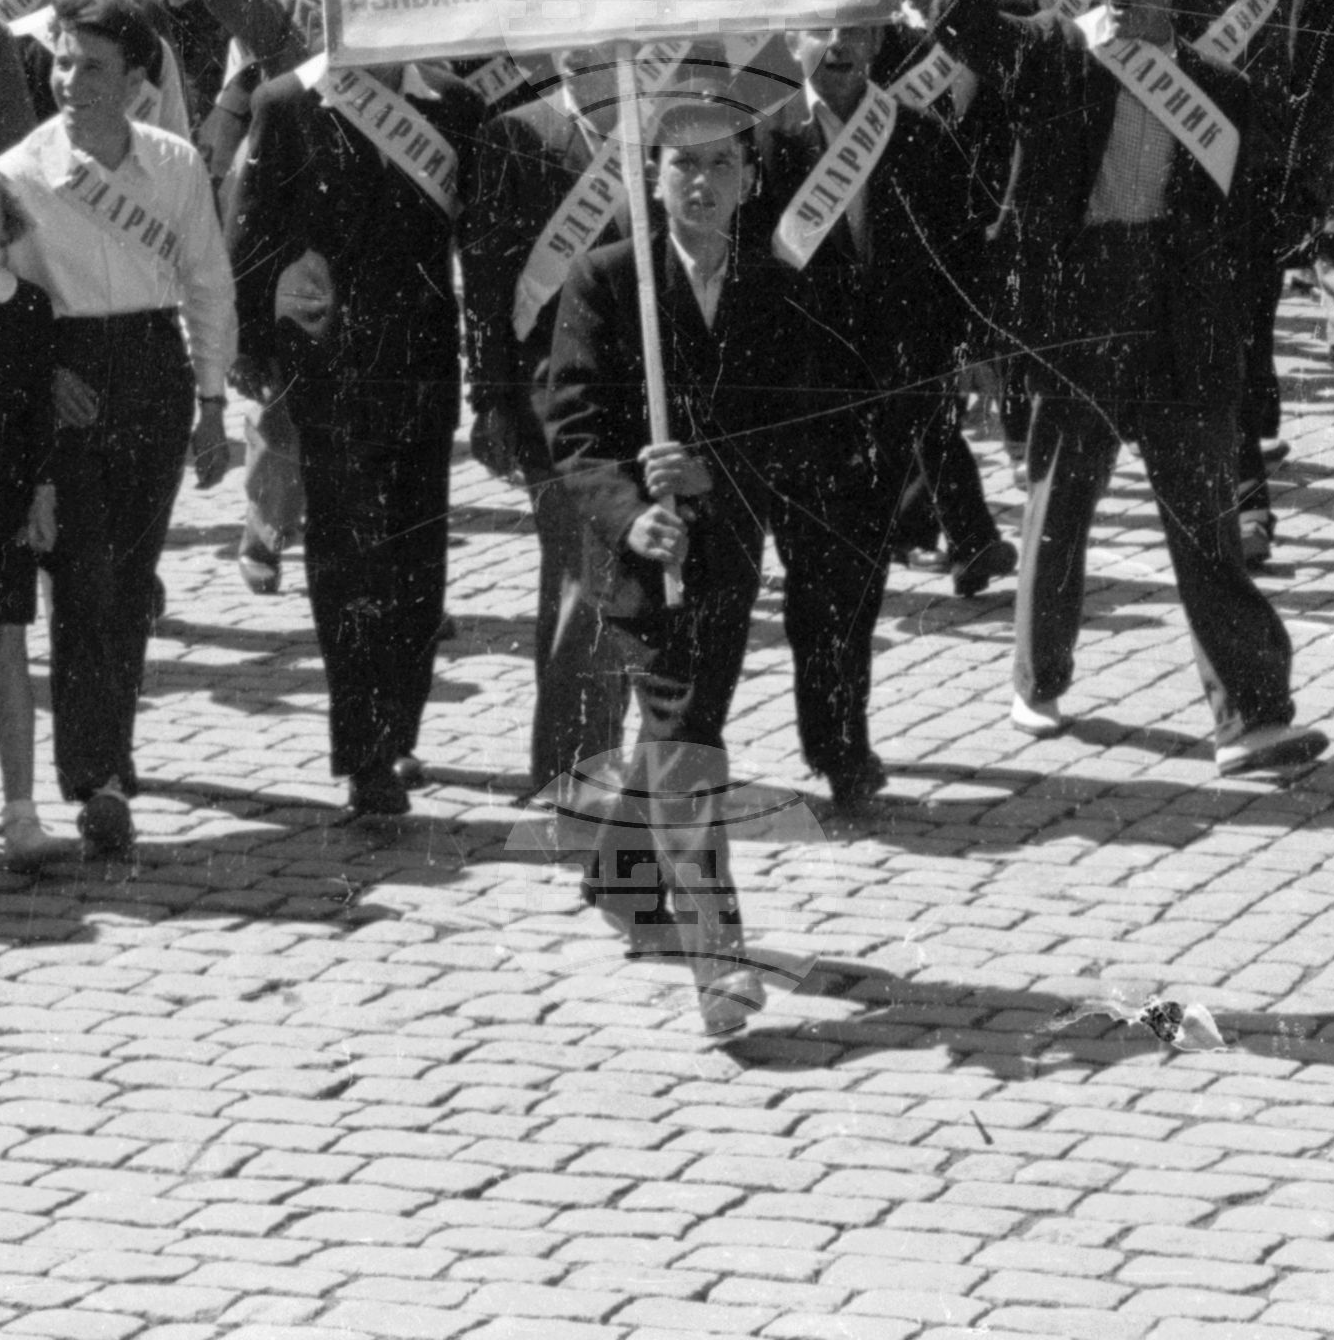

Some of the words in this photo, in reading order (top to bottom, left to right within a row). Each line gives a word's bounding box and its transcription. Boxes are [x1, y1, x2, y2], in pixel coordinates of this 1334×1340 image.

[334, 68, 458, 195] УДАРНИК
[1103, 39, 1222, 149] ДАРНИК
[68, 164, 181, 266] УДАРНИ
[548, 156, 625, 259] УДАРН
[796, 95, 892, 228] УДАРНИК
